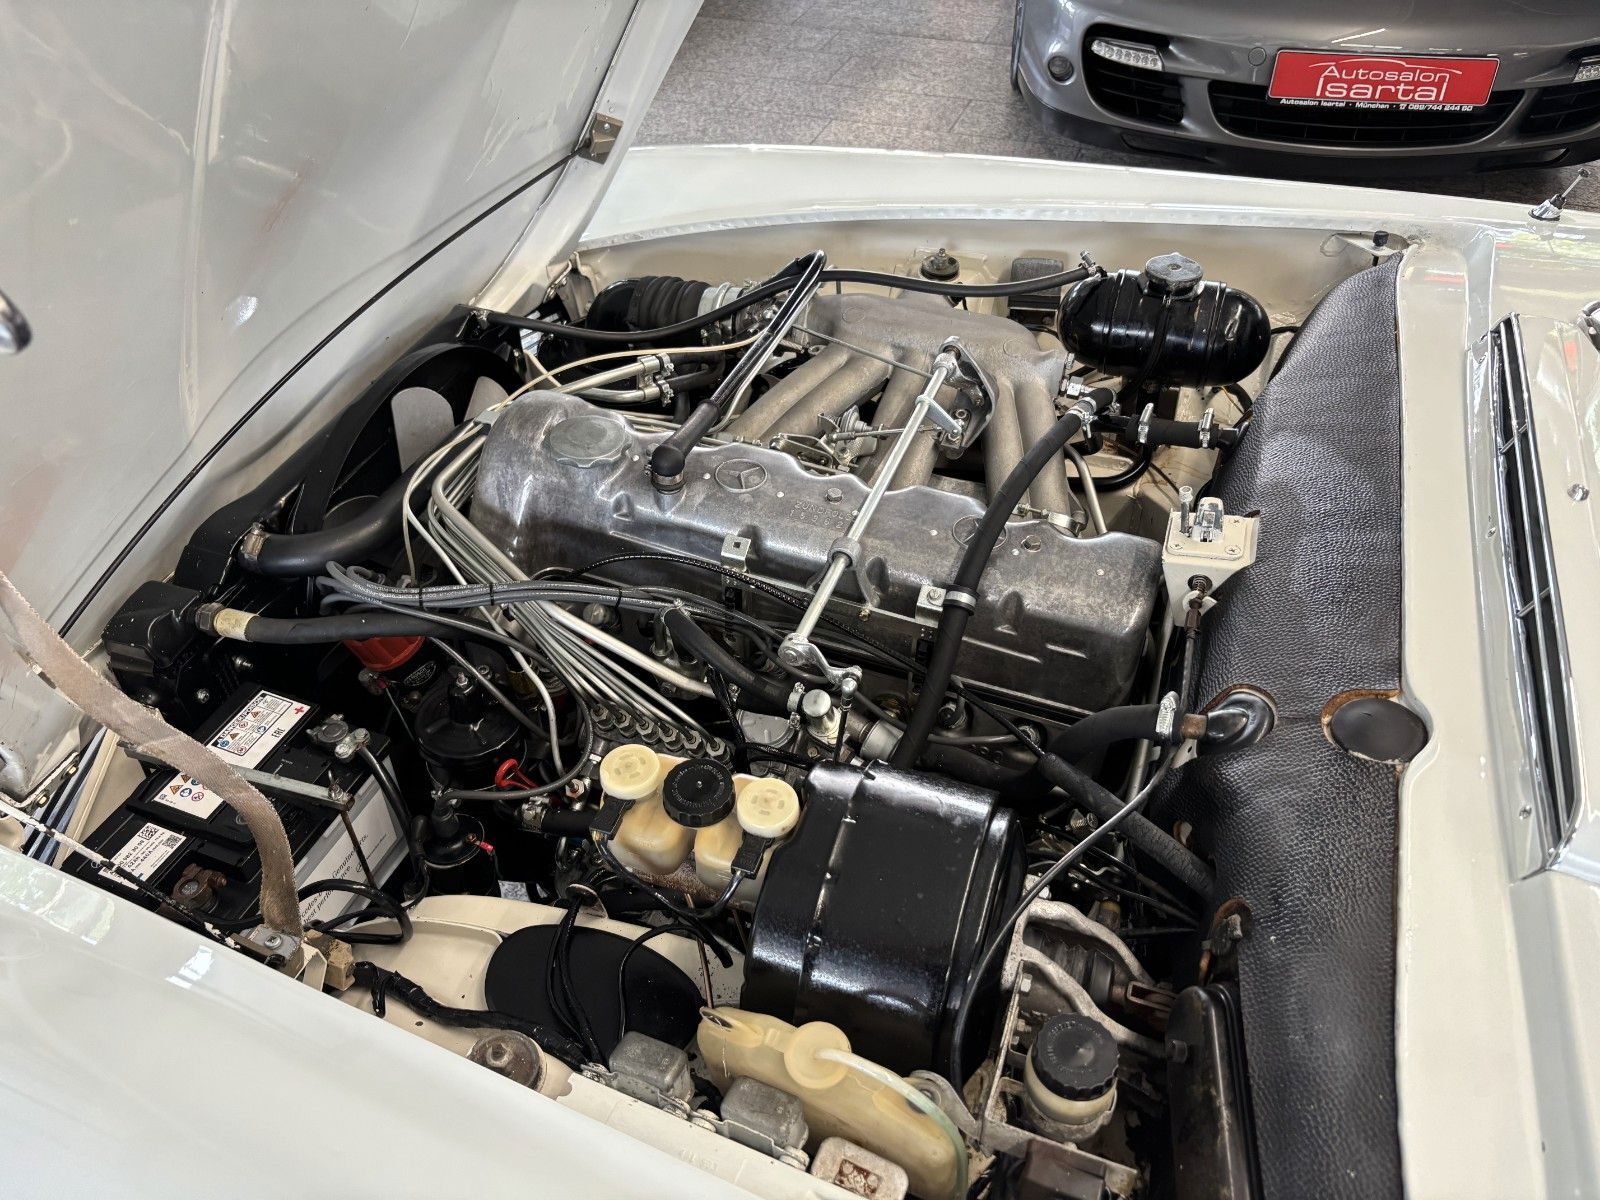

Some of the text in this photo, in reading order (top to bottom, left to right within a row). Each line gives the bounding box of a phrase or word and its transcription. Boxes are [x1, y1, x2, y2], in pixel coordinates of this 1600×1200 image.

[1320, 65, 1450, 83] Autosalon
[1315, 77, 1449, 102] Isartal
[1280, 98, 1319, 106] Autosalon
[1355, 101, 1390, 109] München
